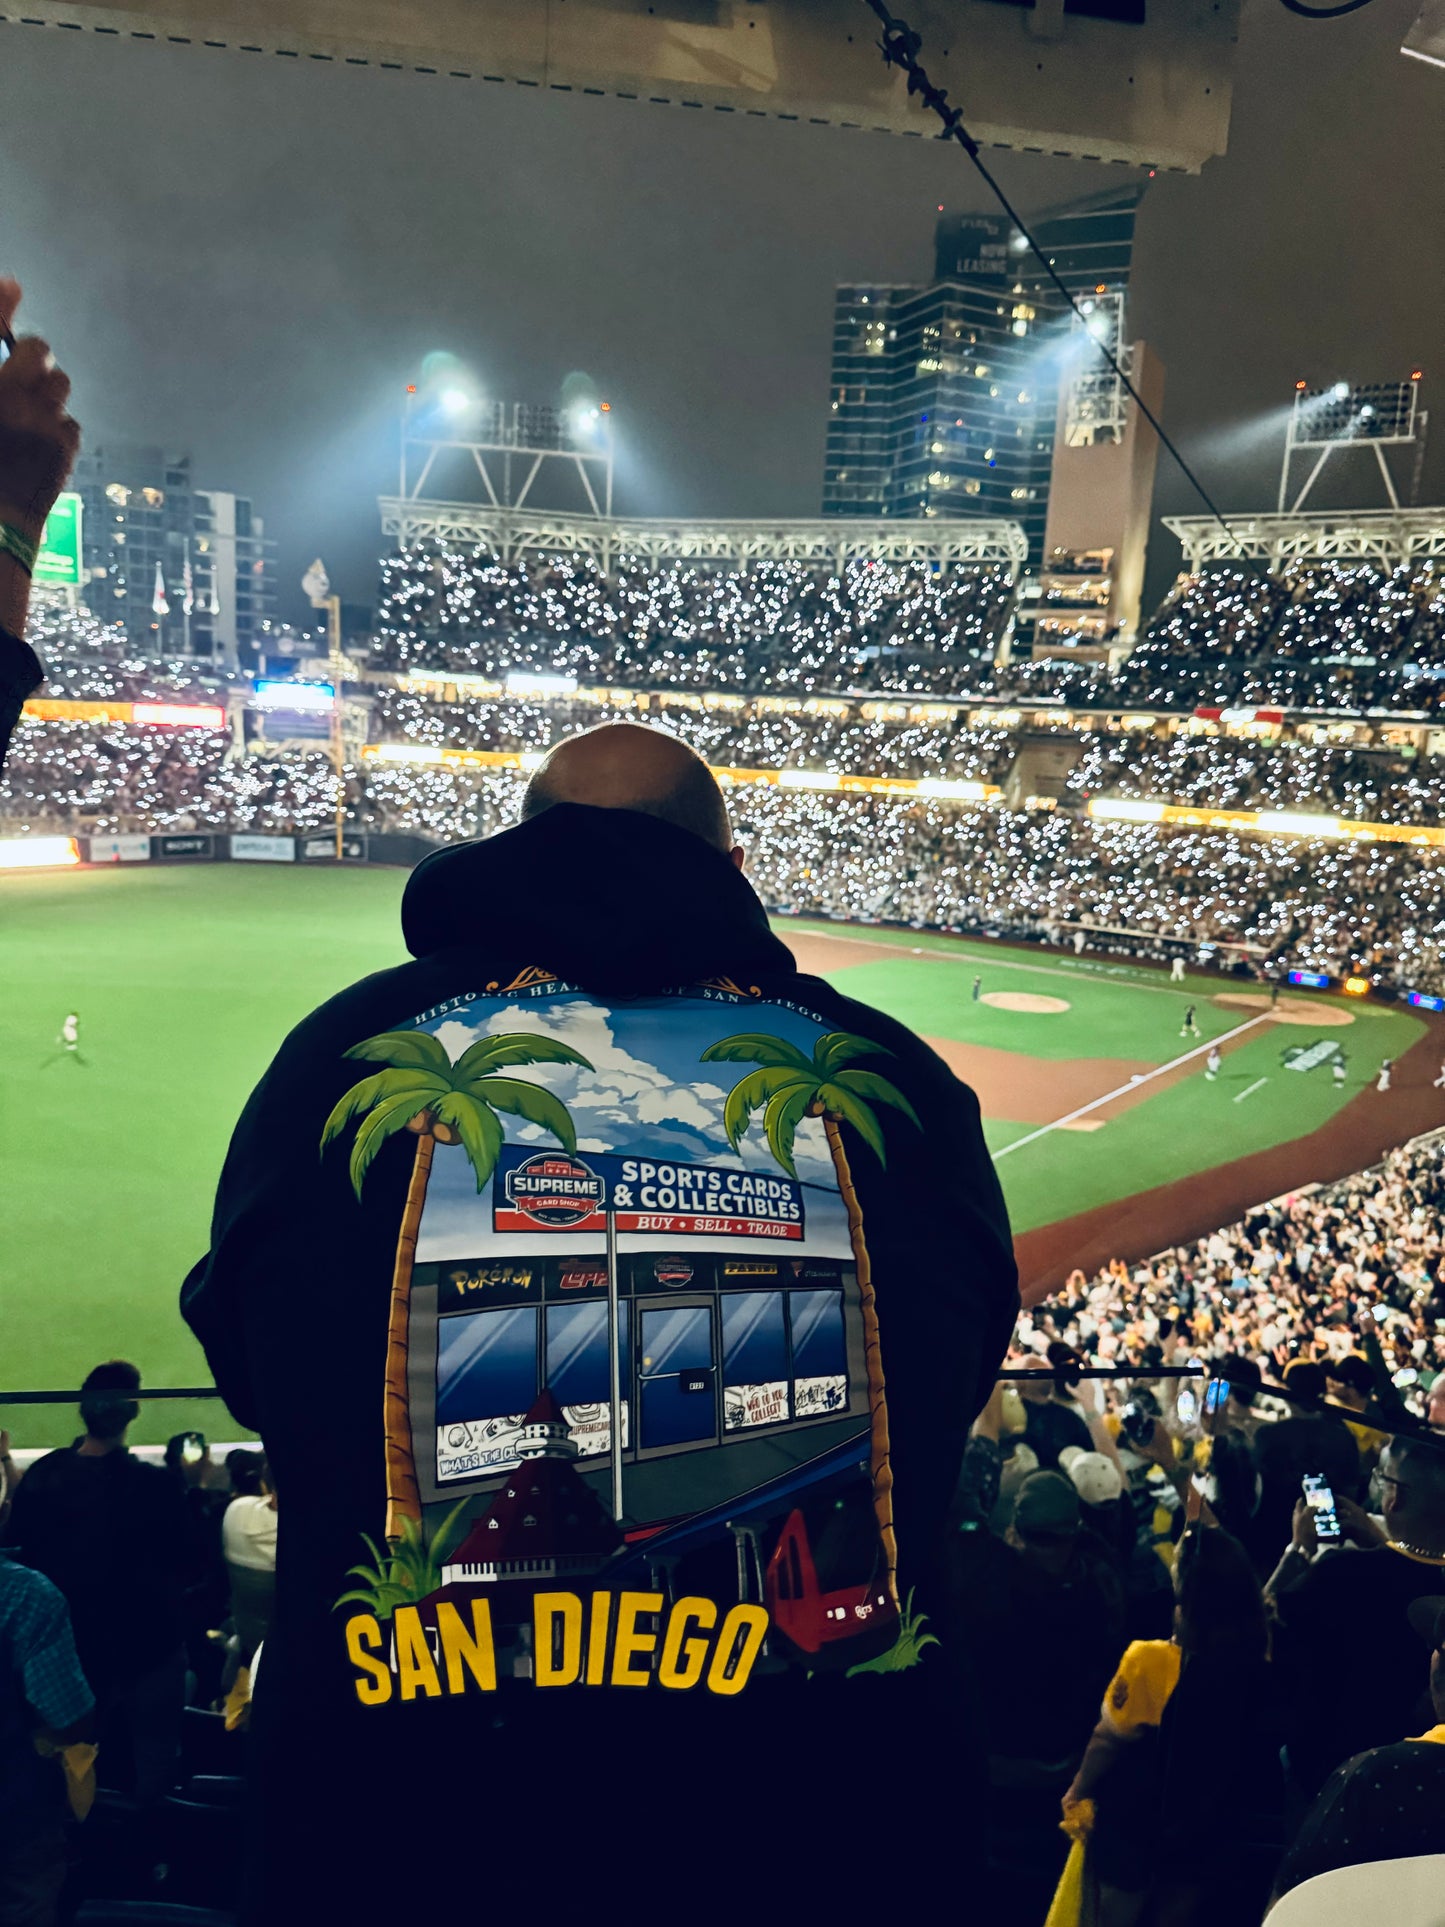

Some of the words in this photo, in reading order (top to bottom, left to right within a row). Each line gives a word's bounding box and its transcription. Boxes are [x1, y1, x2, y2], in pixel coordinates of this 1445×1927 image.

[957, 259, 1007, 273] LEASING
[703, 988, 739, 1003] SAN
[761, 998, 823, 1023] IEGO
[514, 1177, 598, 1194] SUPREME
[622, 1161, 721, 1190] SPORTS
[727, 1174, 792, 1200] CARDS
[536, 1199, 558, 1207] CARD
[613, 1184, 634, 1207] &
[640, 1186, 800, 1220] COLLECTIBLES
[636, 1216, 674, 1230] BUY
[694, 1218, 732, 1232] SELL
[748, 1222, 787, 1236] TRADE
[480, 1447, 502, 1465] THE
[345, 1598, 496, 1706] SAN
[534, 1591, 769, 1696] DIEGO
